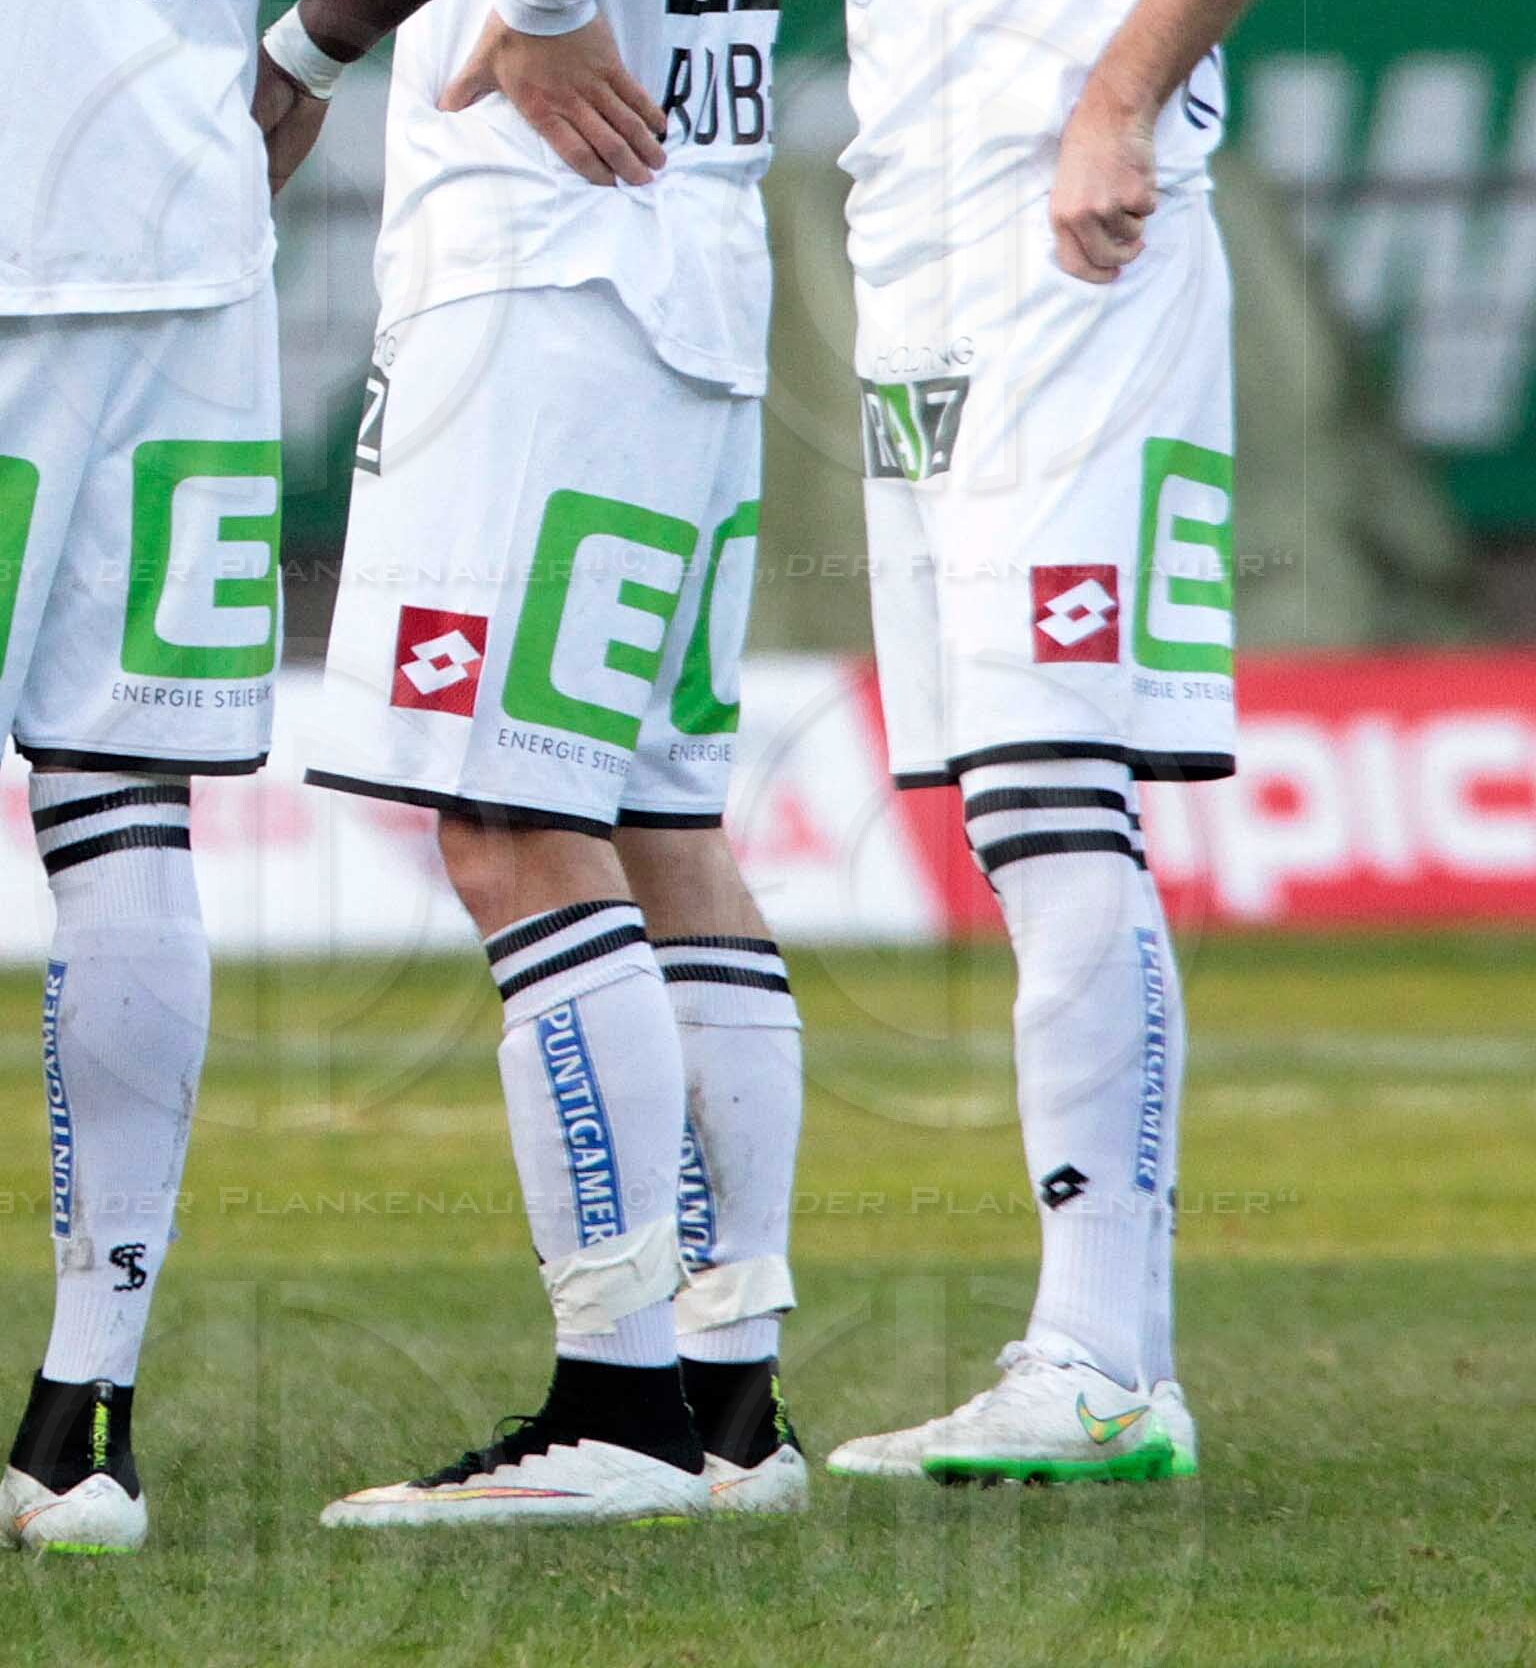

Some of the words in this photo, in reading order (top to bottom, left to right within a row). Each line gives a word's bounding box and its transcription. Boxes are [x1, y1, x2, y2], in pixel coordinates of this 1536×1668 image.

[111, 681, 205, 709] ENERGIE
[497, 728, 585, 765] ENERGIE
[668, 743, 733, 763] ENERGIE
[42, 972, 70, 1225] PUNTIGAMER
[540, 1002, 618, 1247] PUNTIGAMER
